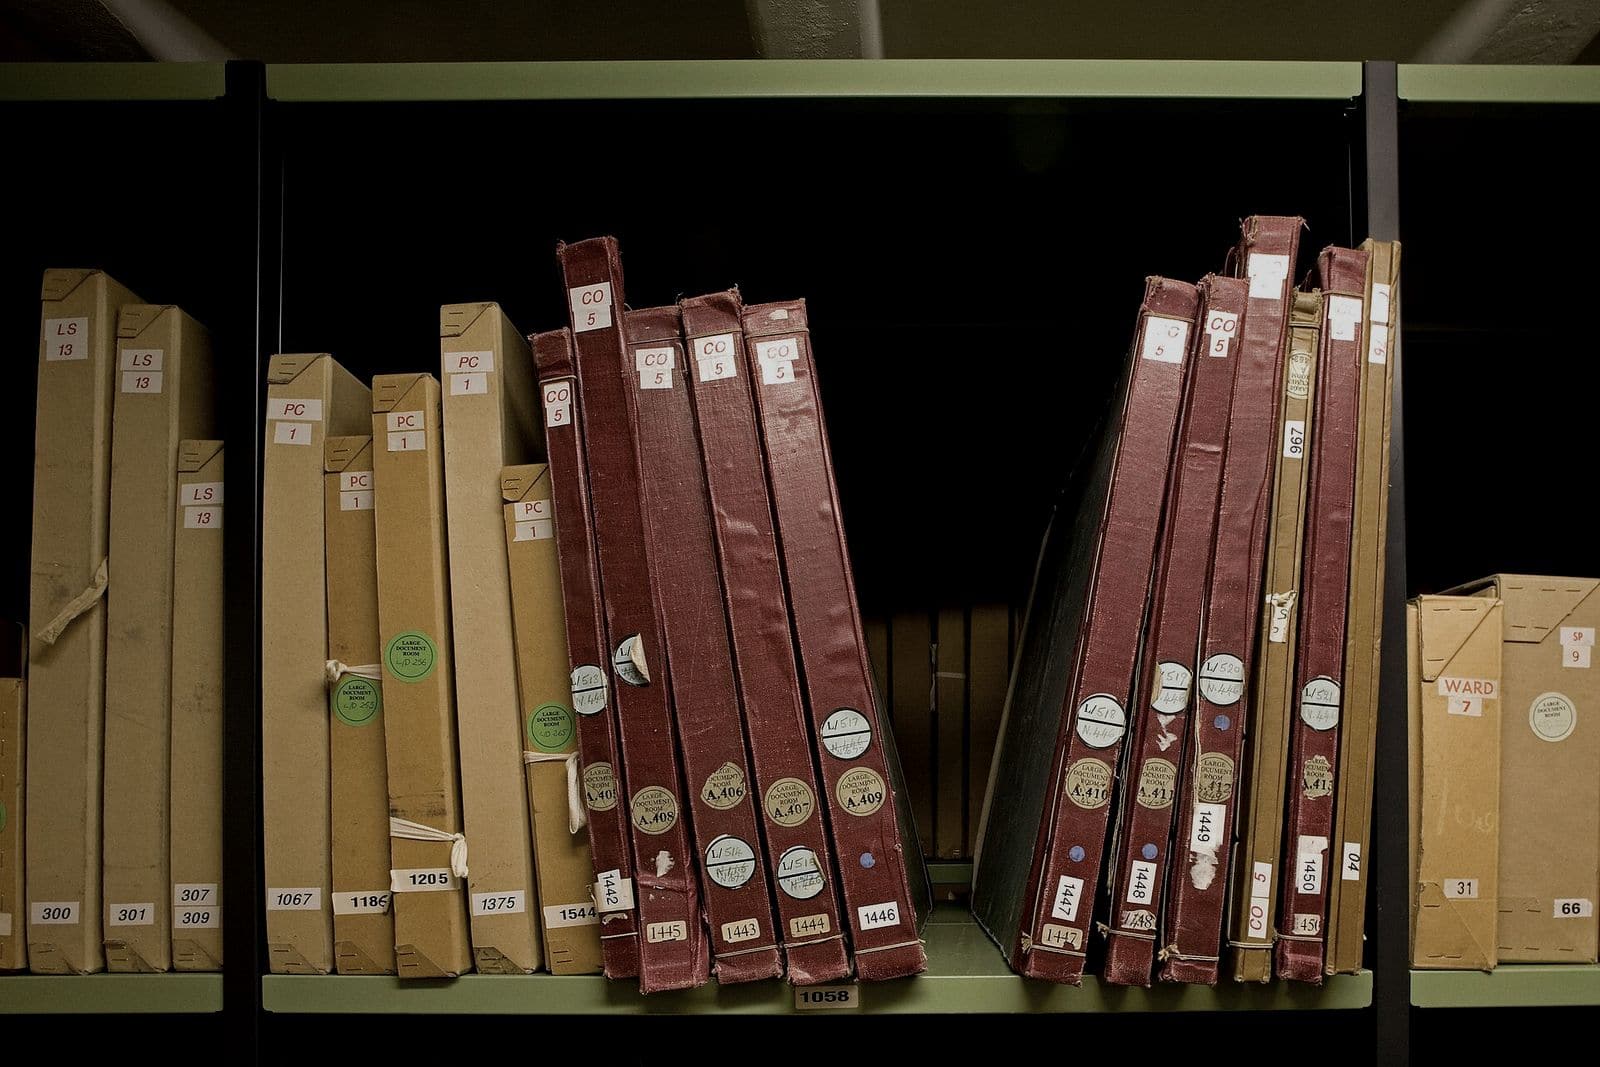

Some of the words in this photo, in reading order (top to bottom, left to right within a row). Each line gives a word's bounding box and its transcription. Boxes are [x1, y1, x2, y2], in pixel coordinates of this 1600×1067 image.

[582, 290, 604, 305] CO
[587, 313, 596, 326] 5
[1210, 318, 1236, 332] CO
[57, 322, 77, 336] LS
[58, 344, 72, 356] 13
[703, 340, 727, 355] CO
[766, 344, 789, 359] CO
[1214, 340, 1224, 352] 5
[132, 354, 152, 366] LS
[458, 356, 480, 368] PC
[644, 353, 668, 366] CO
[715, 362, 724, 375] 5
[776, 366, 786, 379] 5
[136, 377, 150, 388] 13
[464, 379, 470, 390] 1
[655, 373, 664, 385] 5
[546, 388, 569, 403] CO
[284, 404, 305, 416] PC
[554, 409, 563, 421] 5
[397, 415, 415, 427] PC
[290, 428, 296, 440] 1
[402, 438, 407, 448] 1
[1290, 427, 1303, 454] 967
[350, 476, 368, 488] PC
[194, 488, 213, 500] LS
[354, 498, 359, 508] 1
[525, 502, 542, 514] PC
[196, 512, 211, 524] 13
[530, 526, 536, 538] 1
[1572, 632, 1584, 642] SP
[1572, 650, 1580, 663] 9
[1206, 662, 1240, 674] L/520
[1444, 678, 1494, 695] WARD
[1084, 703, 1116, 719] L/518
[1462, 700, 1472, 713] 7
[1082, 765, 1102, 773] LARGE
[1146, 765, 1167, 773] LARGE
[1204, 760, 1226, 768] LARGE
[712, 780, 732, 788] ROOM
[848, 774, 868, 782] LARGE
[1080, 778, 1100, 786] ROOM
[1146, 778, 1166, 786] ROOM
[842, 779, 877, 790] DOCUMENT
[642, 792, 663, 800] LARGE
[707, 787, 744, 801] A.406
[770, 790, 806, 800] DOCUMENT
[851, 787, 870, 796] ROOM
[636, 798, 670, 807] DOCUMENT
[846, 791, 882, 808] A.409
[639, 811, 674, 826] A.408
[1197, 810, 1212, 842] 1449
[1347, 852, 1361, 872] 04
[409, 872, 448, 885] 1205
[1254, 872, 1267, 883] 5
[1302, 859, 1316, 892] 1450
[1132, 867, 1150, 899] 1448
[1456, 881, 1473, 896] 31
[181, 889, 210, 901] 307
[602, 874, 619, 905] 1442
[277, 893, 313, 906] 1067
[482, 896, 516, 910] 1375
[1058, 883, 1076, 917] 1447
[42, 907, 71, 920] 300
[118, 908, 146, 921] 301
[560, 906, 598, 920] 1544
[1560, 903, 1582, 914] 66
[182, 912, 210, 924] 309
[864, 908, 896, 924] 1446
[1250, 906, 1264, 931] CO
[651, 924, 681, 939] 1445
[727, 923, 756, 940] 1443
[795, 918, 824, 933] 1444
[1046, 928, 1078, 944] 1447
[800, 990, 850, 1002] 1058
